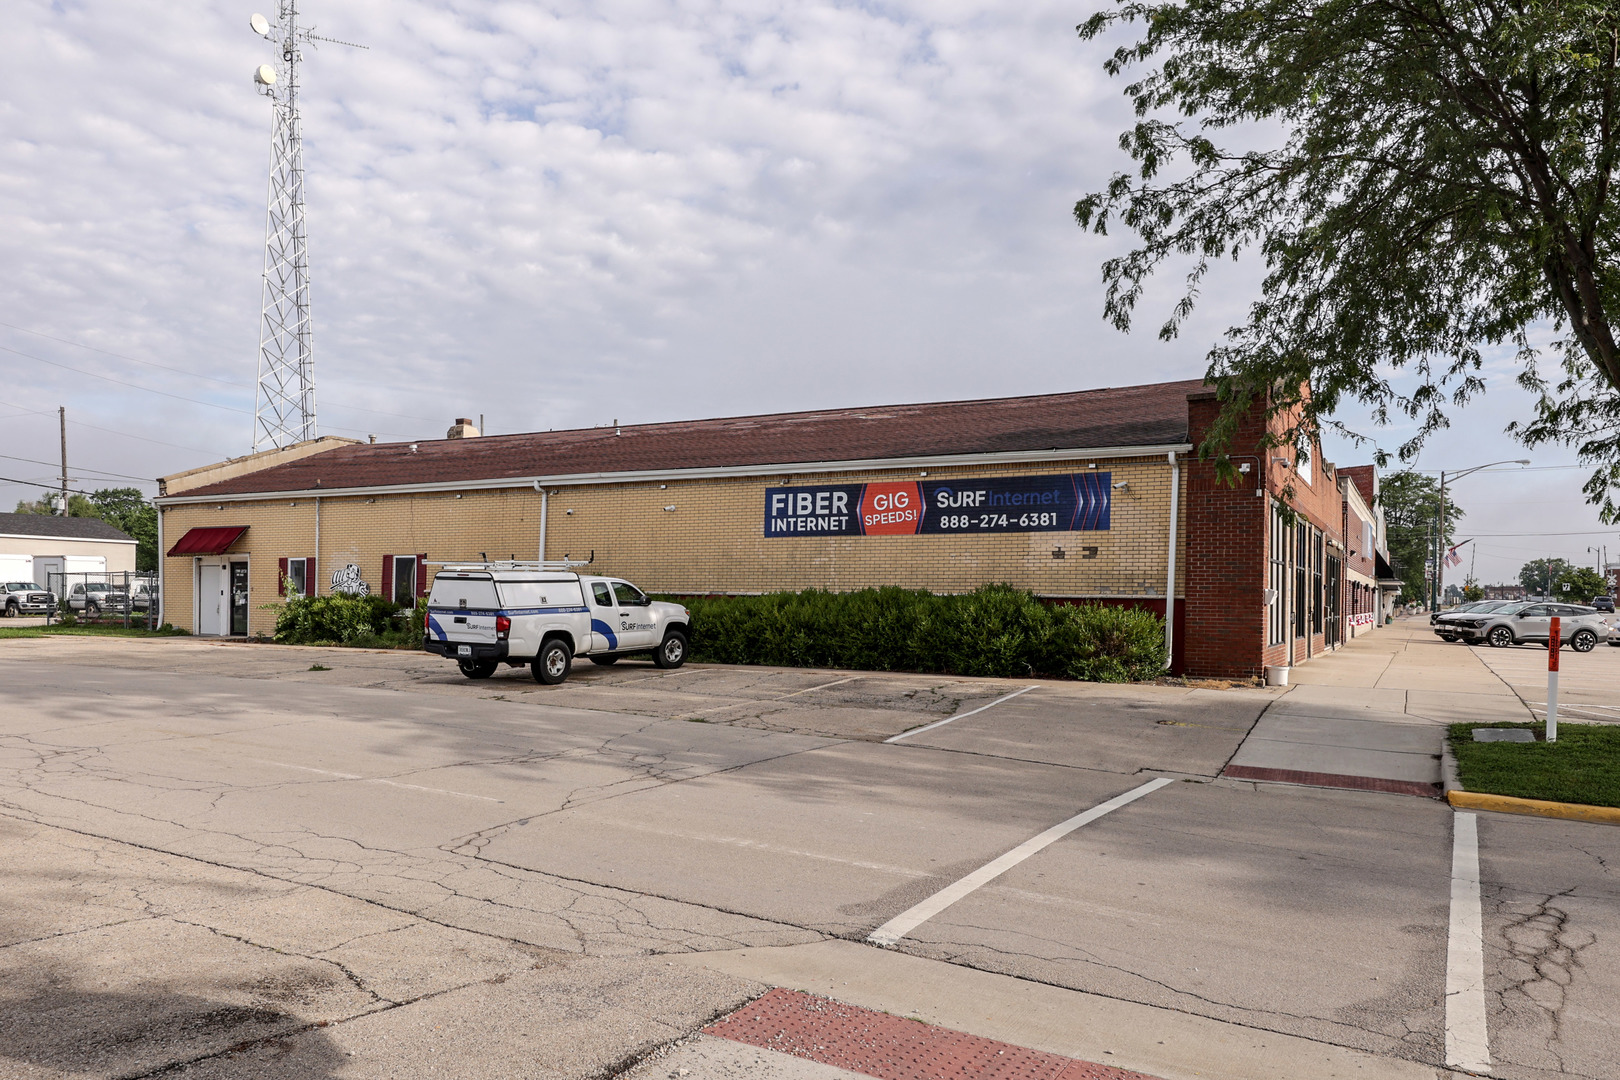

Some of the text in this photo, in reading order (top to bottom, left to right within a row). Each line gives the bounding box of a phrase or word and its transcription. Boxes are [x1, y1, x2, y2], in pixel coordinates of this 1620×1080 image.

[771, 491, 849, 516] FIBER
[873, 491, 909, 511] GIG
[936, 489, 1061, 508] SURF Internet
[771, 516, 849, 532] INTERNET
[865, 509, 917, 526] SPEEDS!
[940, 512, 1057, 529] 888-274-6381
[621, 621, 656, 631] SURF Internet
